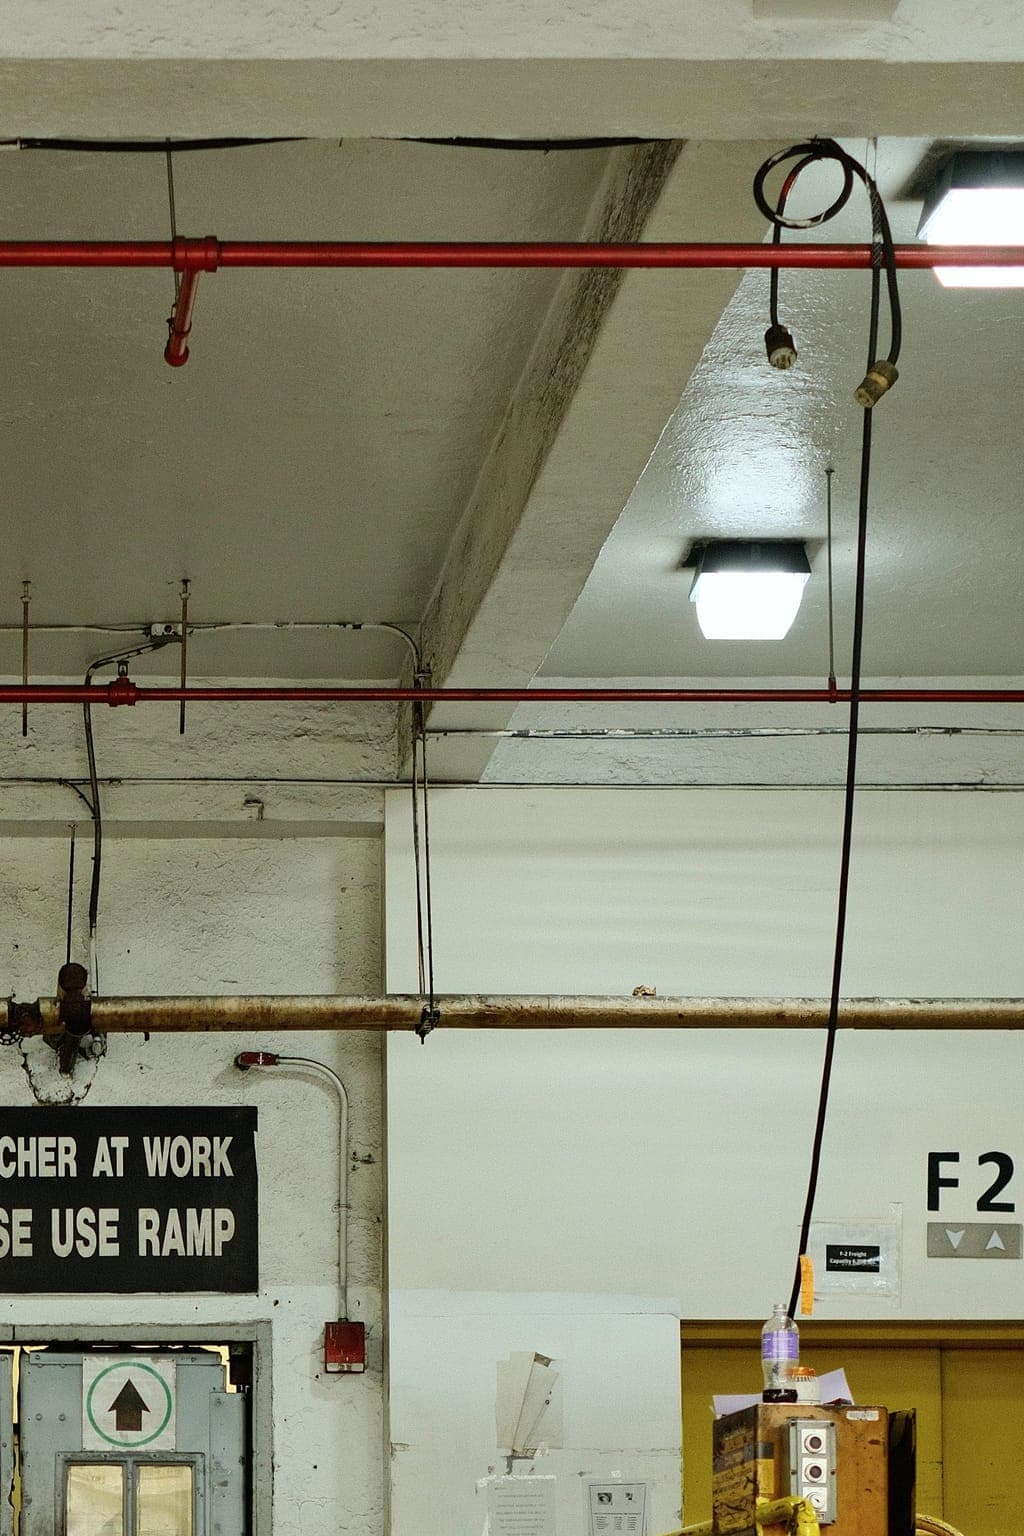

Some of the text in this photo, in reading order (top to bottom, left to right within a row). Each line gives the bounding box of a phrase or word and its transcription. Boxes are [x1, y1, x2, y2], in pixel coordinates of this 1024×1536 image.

[93, 1137, 129, 1178] AT
[146, 1136, 234, 1178] WORK
[51, 1207, 120, 1258] USE
[138, 1207, 235, 1258] RAMP
